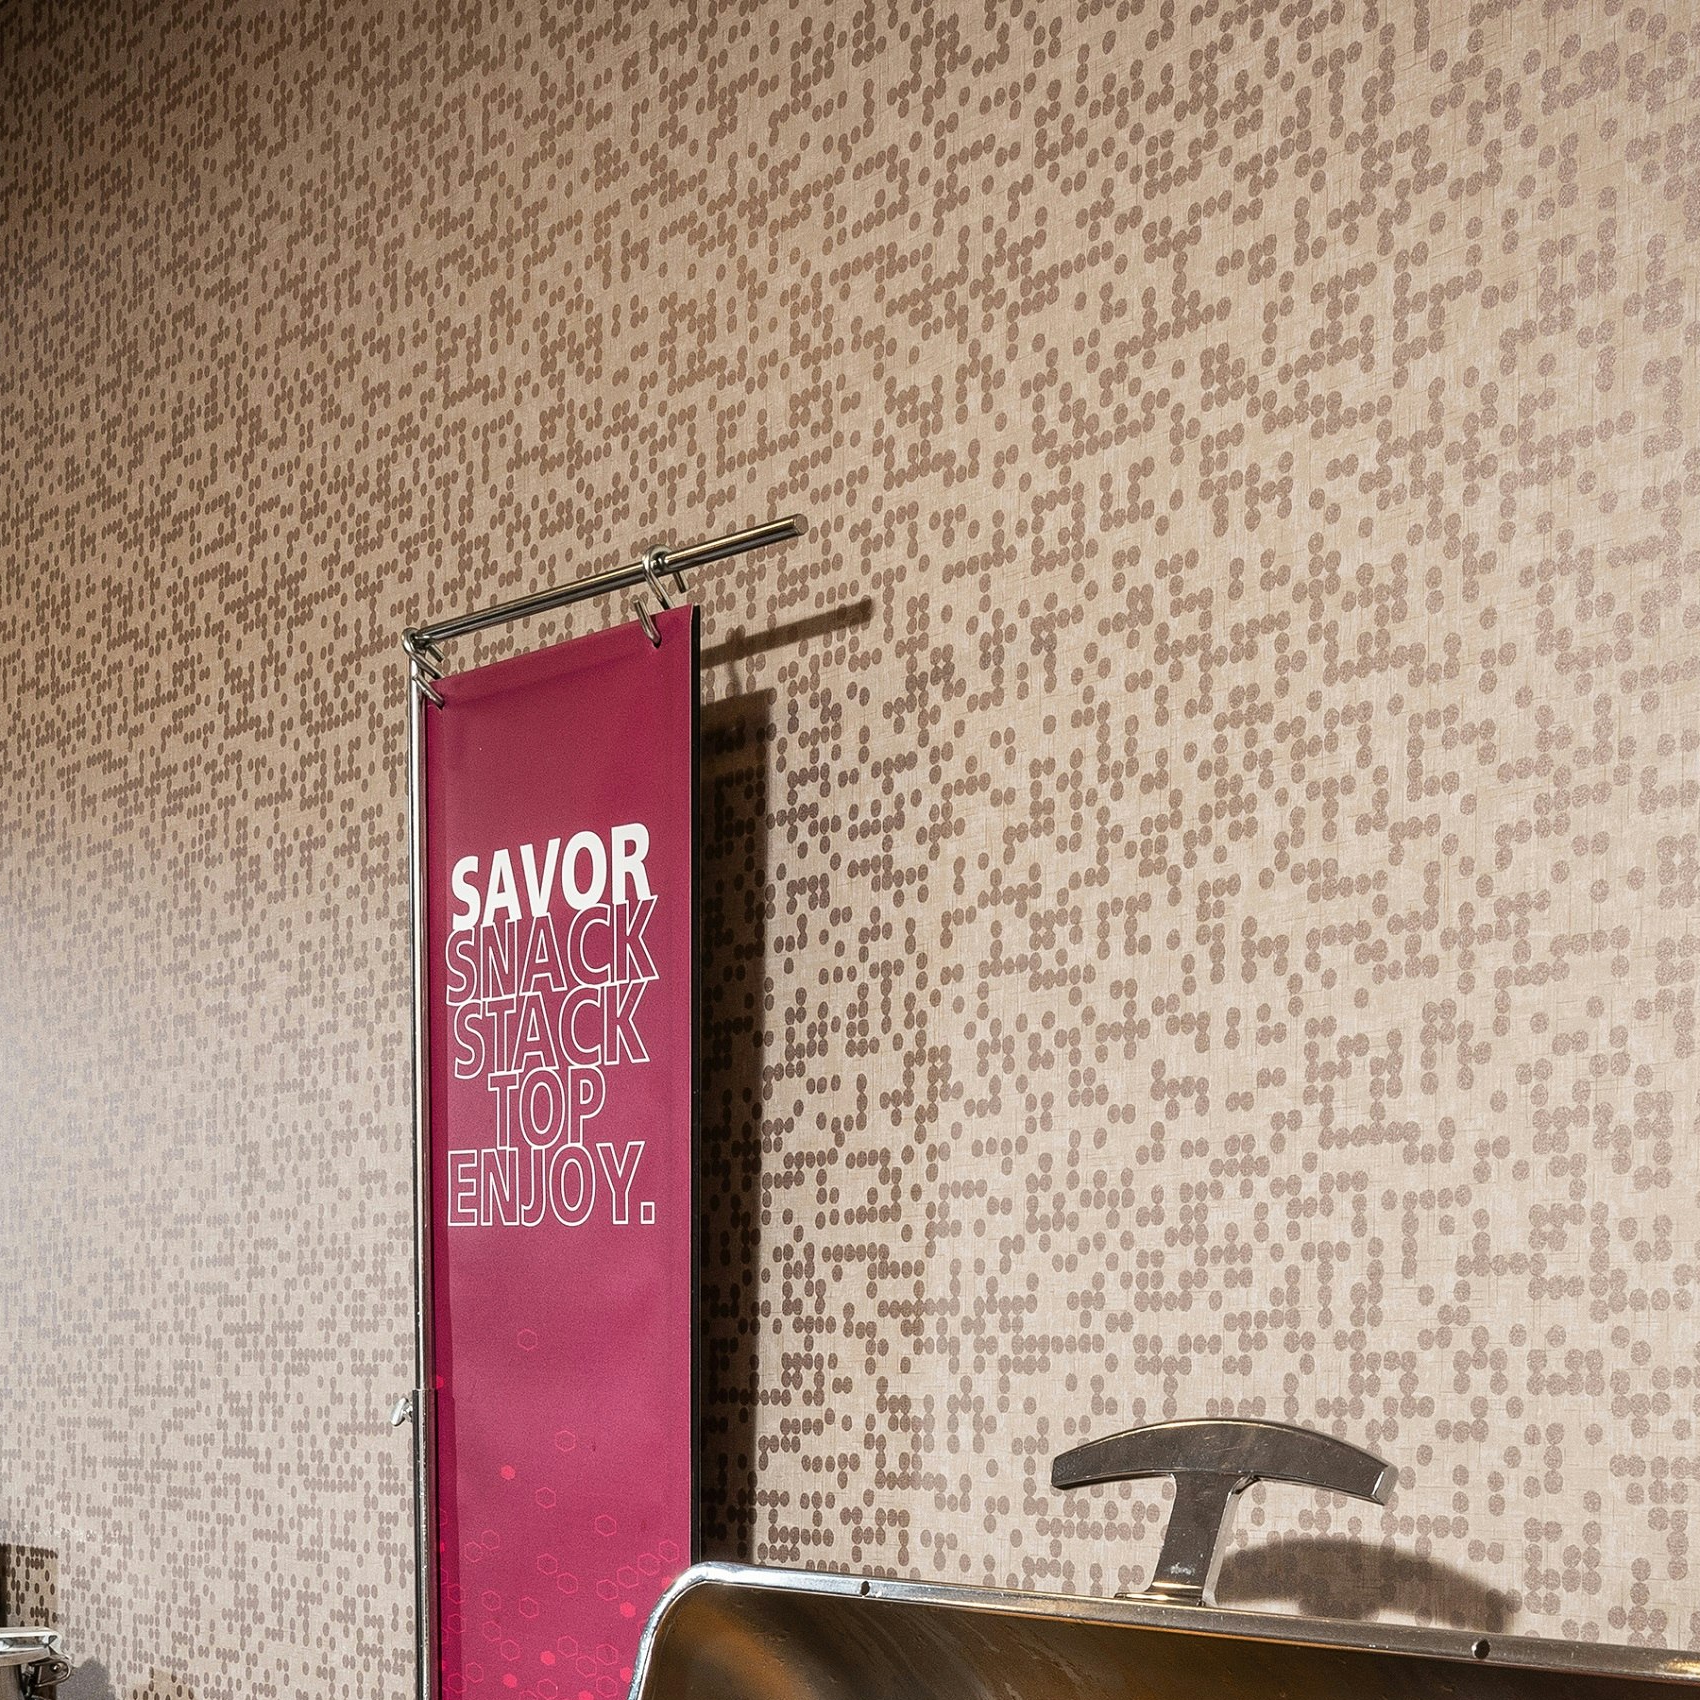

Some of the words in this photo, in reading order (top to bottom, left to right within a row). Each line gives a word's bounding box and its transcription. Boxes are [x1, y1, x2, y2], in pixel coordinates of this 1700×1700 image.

[452, 822, 651, 931] SAVOR
[446, 894, 659, 1007] SNACK
[453, 979, 650, 1079] STACK
[488, 1067, 606, 1150] TOP
[447, 1141, 656, 1228] ENJOY.
